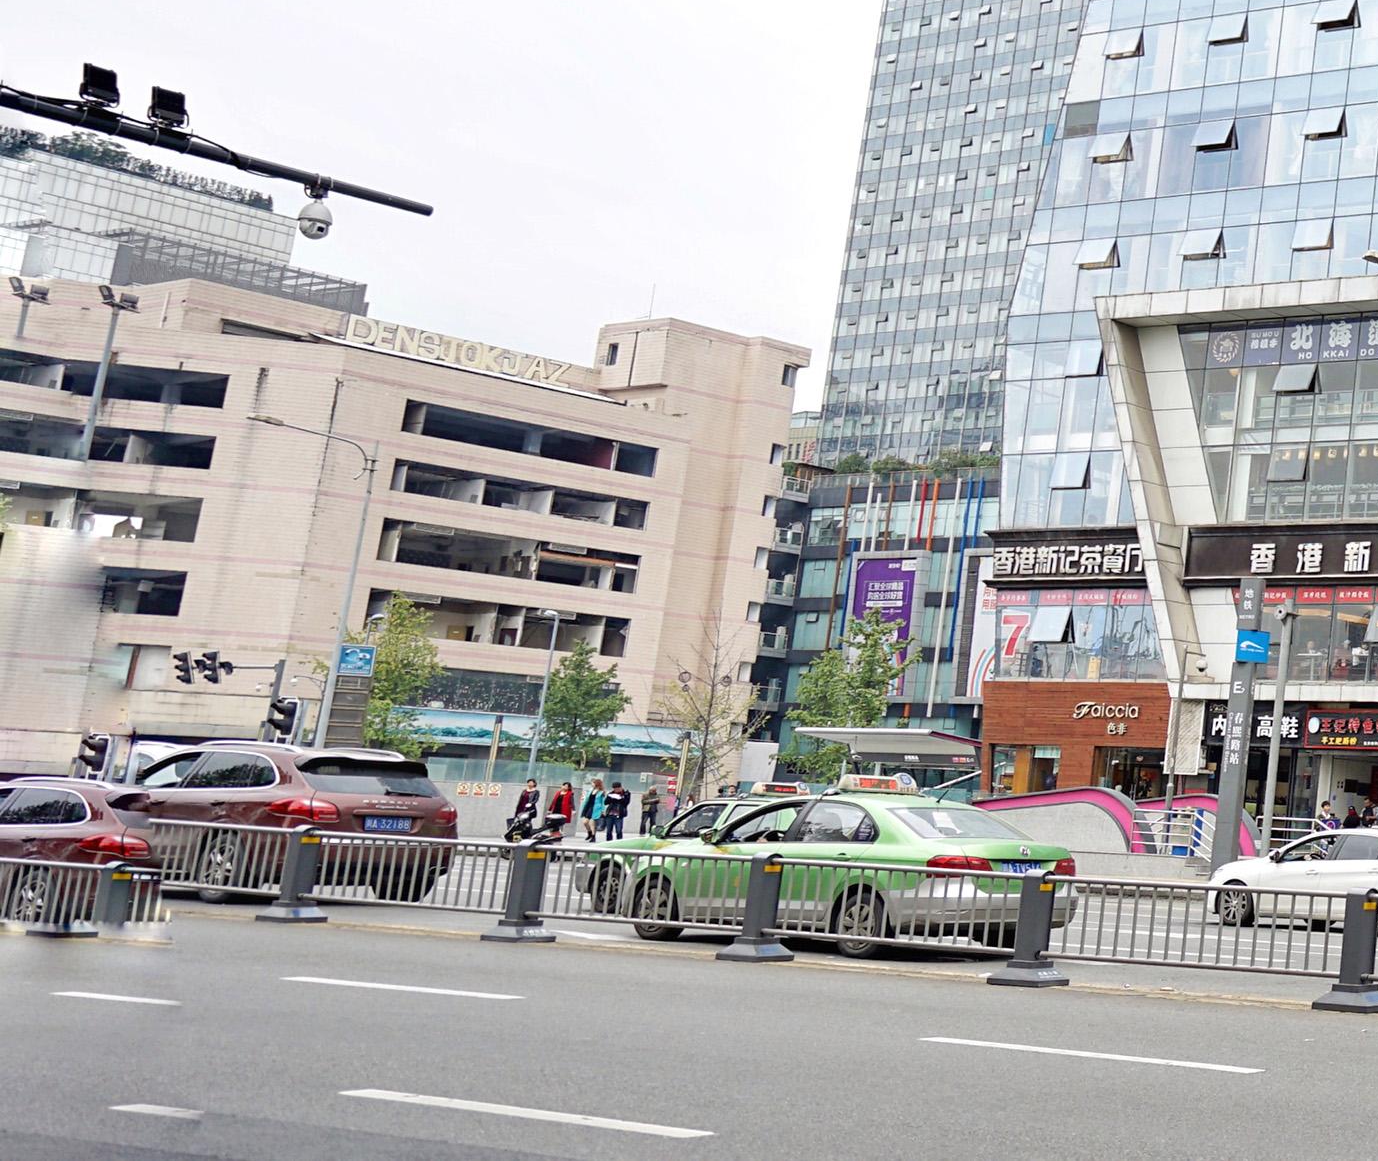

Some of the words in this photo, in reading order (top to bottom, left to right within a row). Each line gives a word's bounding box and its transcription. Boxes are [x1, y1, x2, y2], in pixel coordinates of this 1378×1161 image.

[994, 543, 1144, 576] 香港新记茶餐厅
[1243, 588, 1254, 611] 地铁
[1073, 701, 1139, 719] Faiccia
[1211, 715, 1299, 739] 内高鞋
[1229, 712, 1244, 765] 春熙路站
